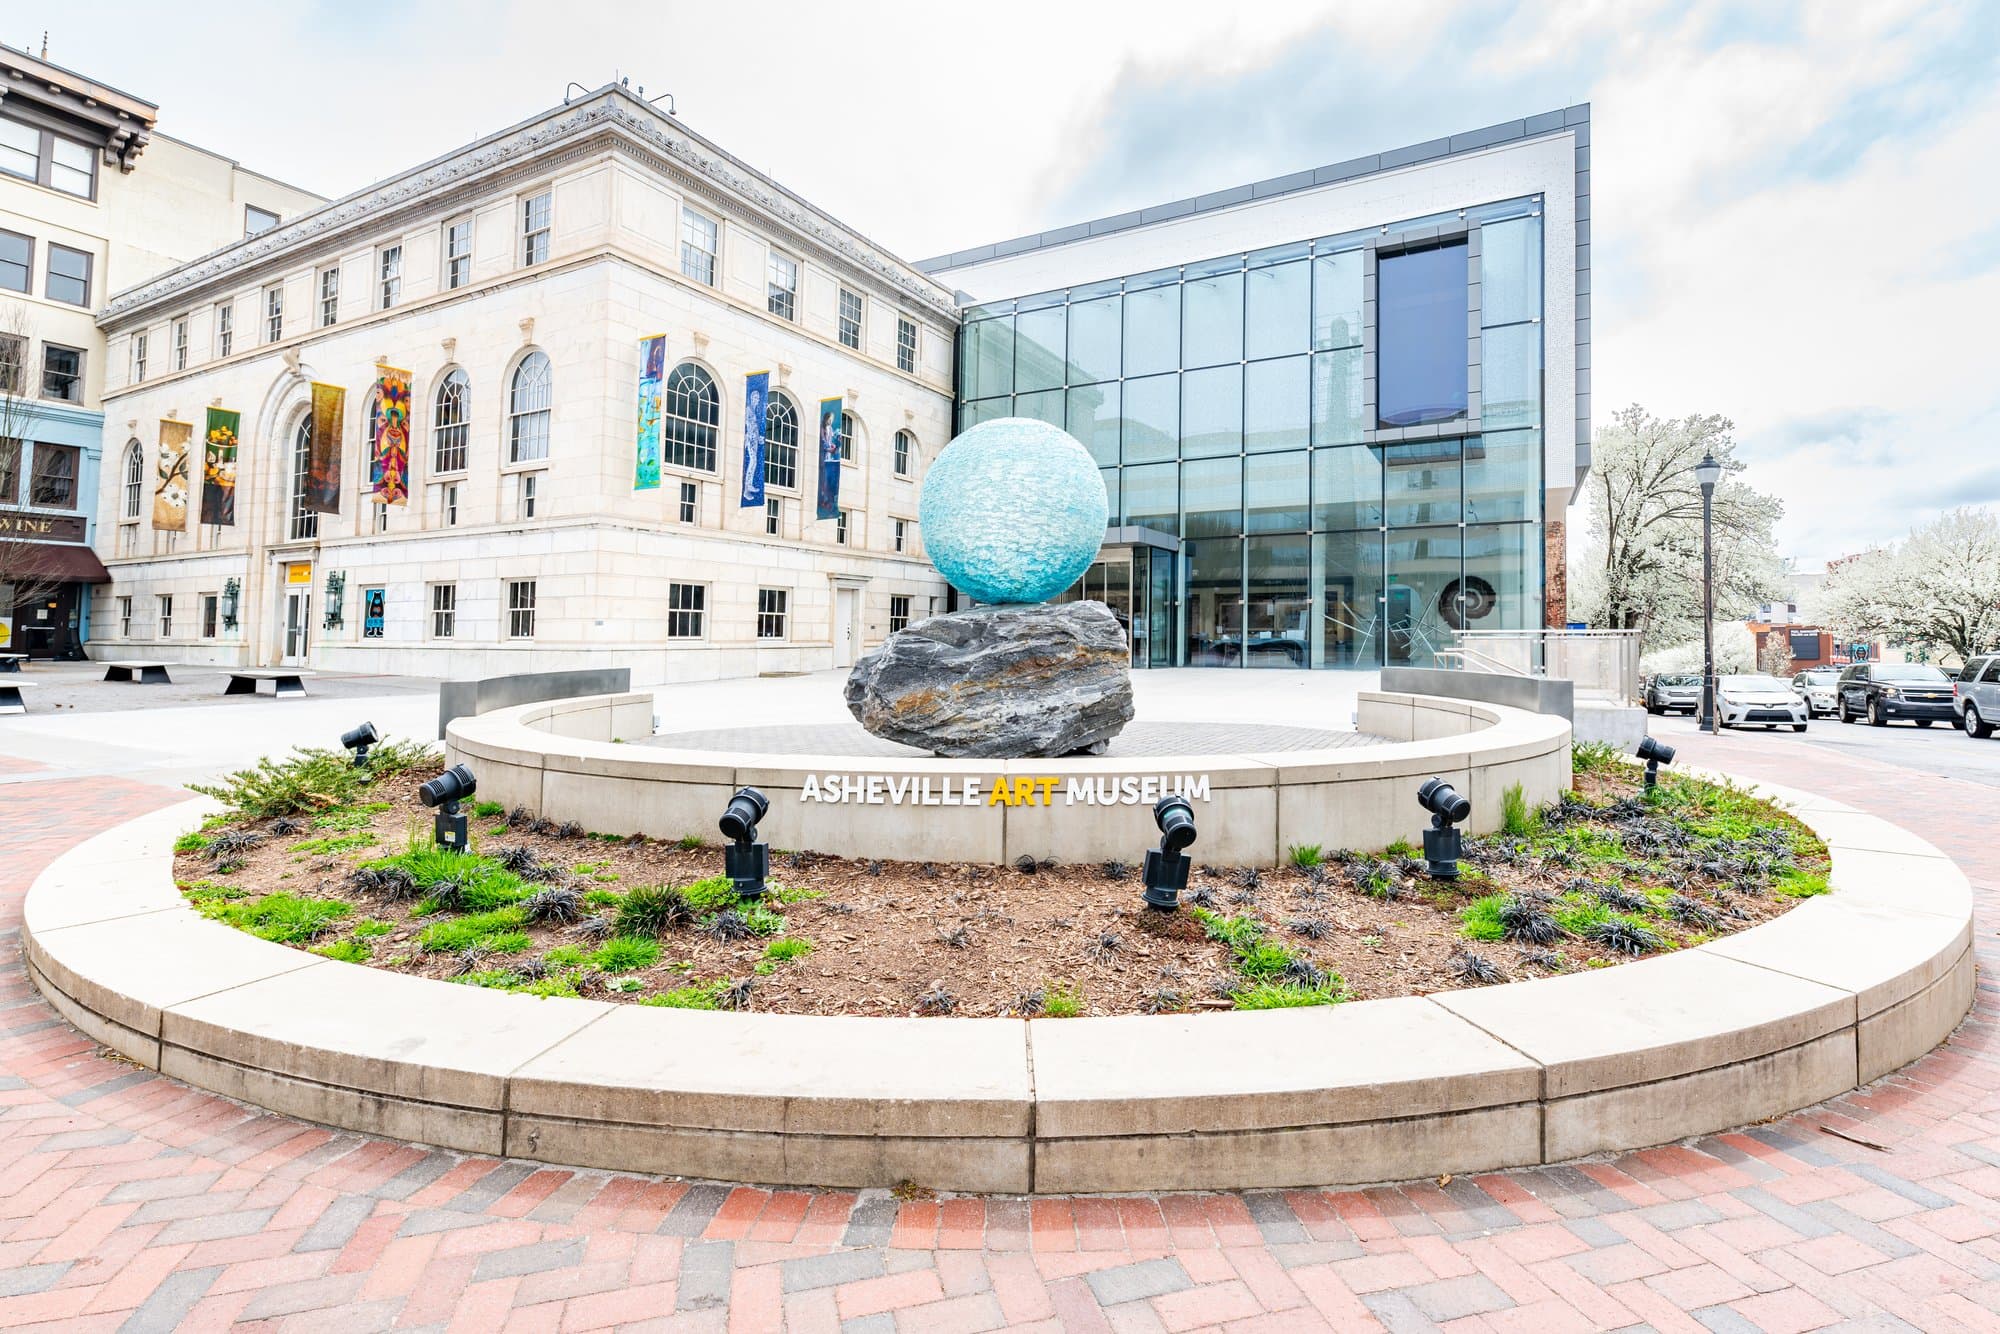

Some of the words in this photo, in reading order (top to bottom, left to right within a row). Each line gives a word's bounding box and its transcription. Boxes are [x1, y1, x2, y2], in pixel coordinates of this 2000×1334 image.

[0, 518, 52, 533] WINE
[800, 774, 981, 805] ASHEVILLE
[988, 776, 1060, 806] ART
[1066, 774, 1211, 806] MUSEUM
